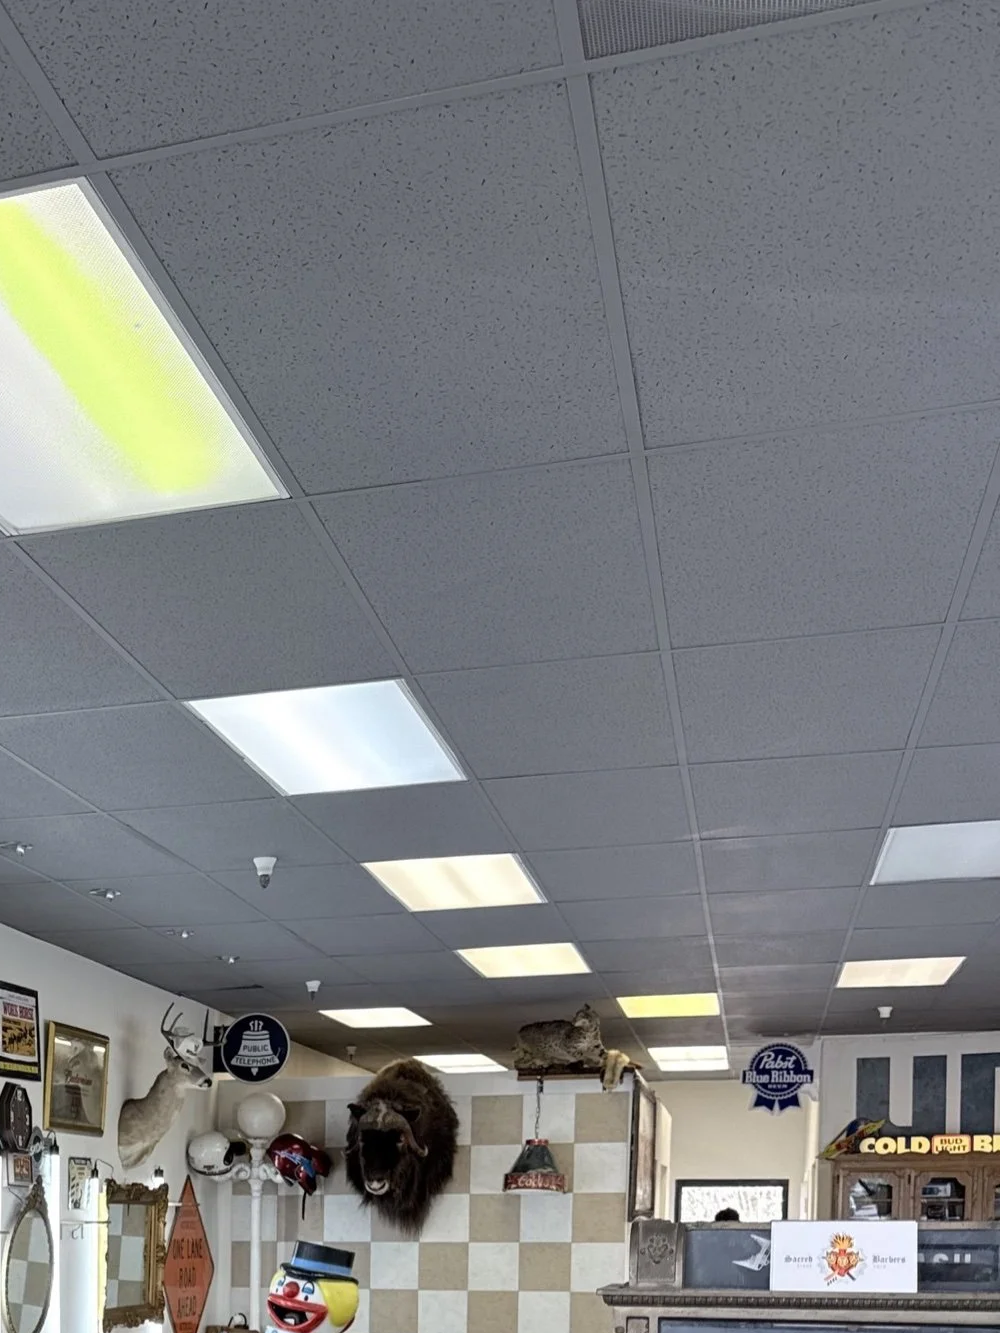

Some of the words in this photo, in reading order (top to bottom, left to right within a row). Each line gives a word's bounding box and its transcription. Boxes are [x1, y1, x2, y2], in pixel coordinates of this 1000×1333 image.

[242, 1044, 269, 1053] PUBLIC
[235, 1055, 277, 1066] TELEPHONE
[759, 1051, 798, 1070] Pabst
[745, 1071, 770, 1083] Blue
[771, 1070, 812, 1083] Ribbon
[859, 1136, 931, 1155] COLD
[173, 1238, 184, 1260] ONE
[187, 1238, 203, 1260] LANE
[179, 1268, 197, 1289] ROAD
[177, 1296, 198, 1318] AHEAD
